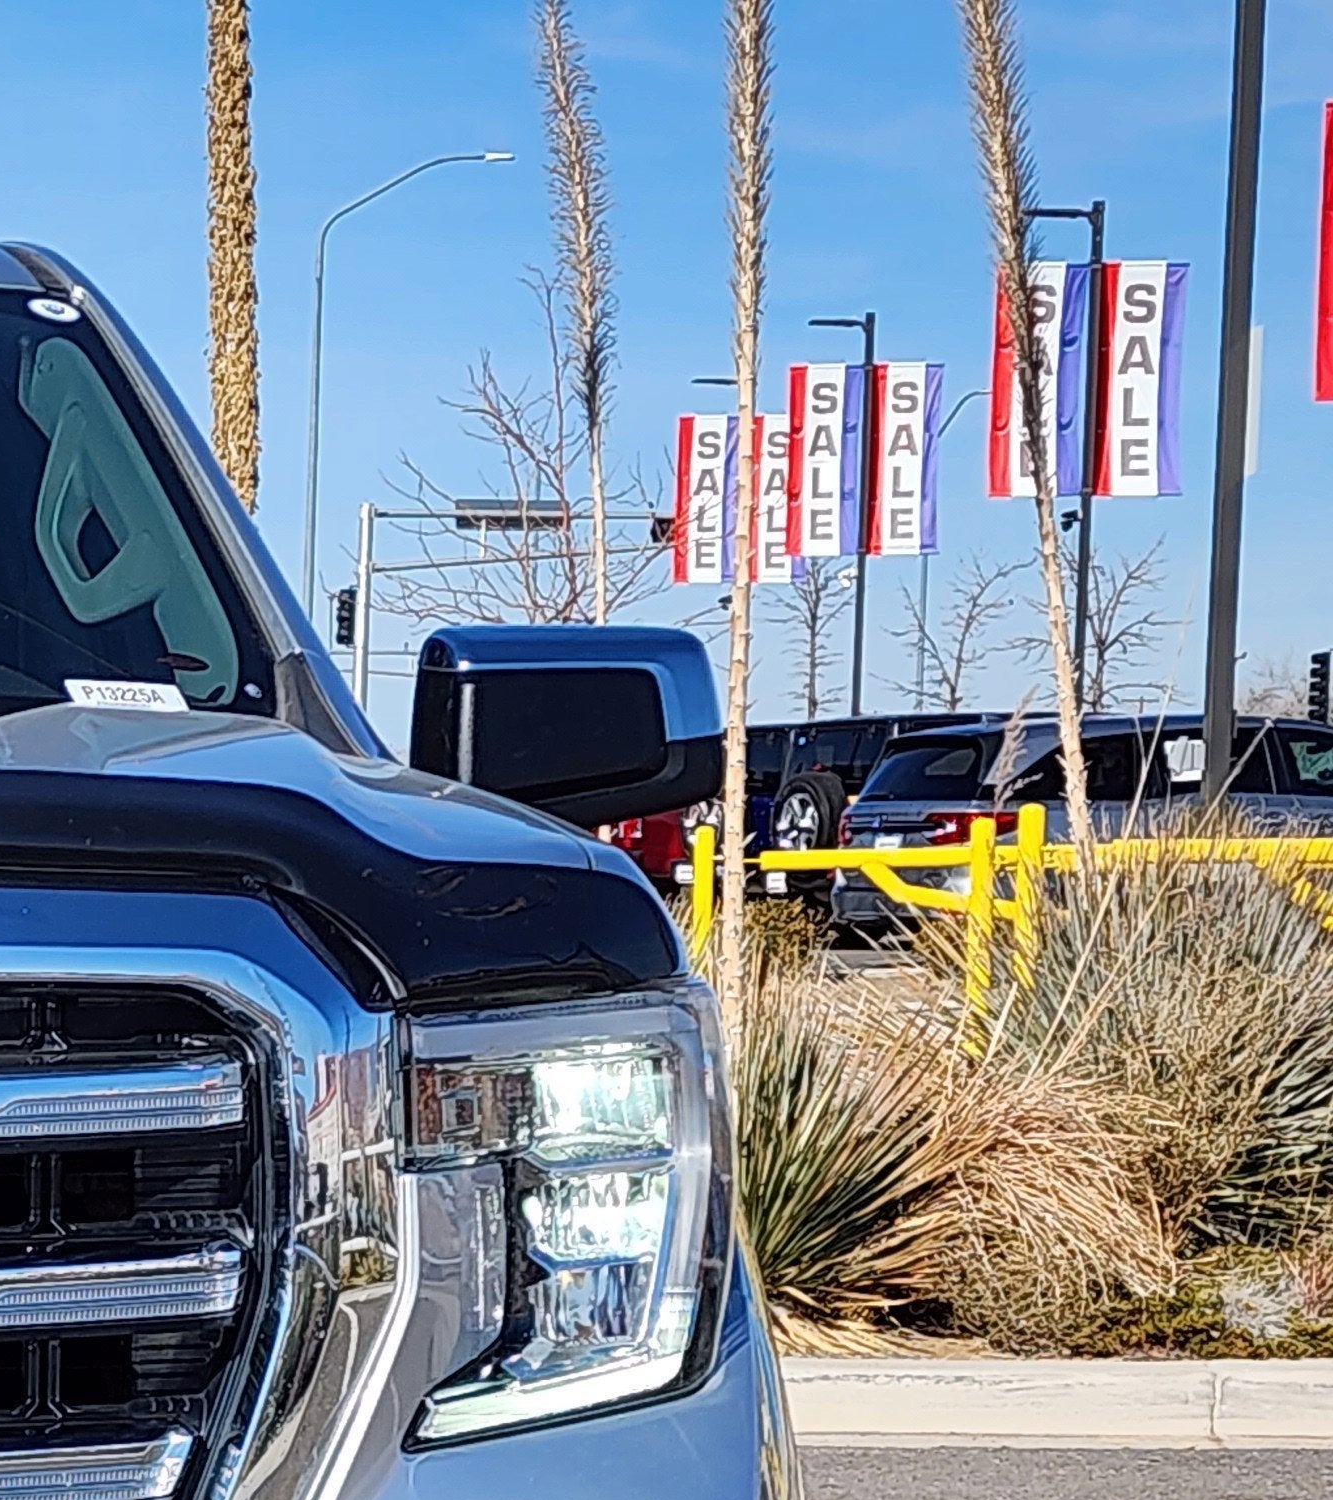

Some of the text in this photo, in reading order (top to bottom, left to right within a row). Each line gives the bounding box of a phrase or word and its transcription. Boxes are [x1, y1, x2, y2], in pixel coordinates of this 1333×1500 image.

[1117, 283, 1157, 477] SALE
[693, 431, 721, 569] SALE
[763, 431, 790, 569] SALE
[808, 382, 839, 540] SALE
[887, 381, 919, 539] SALE
[82, 685, 166, 704] P13225A
